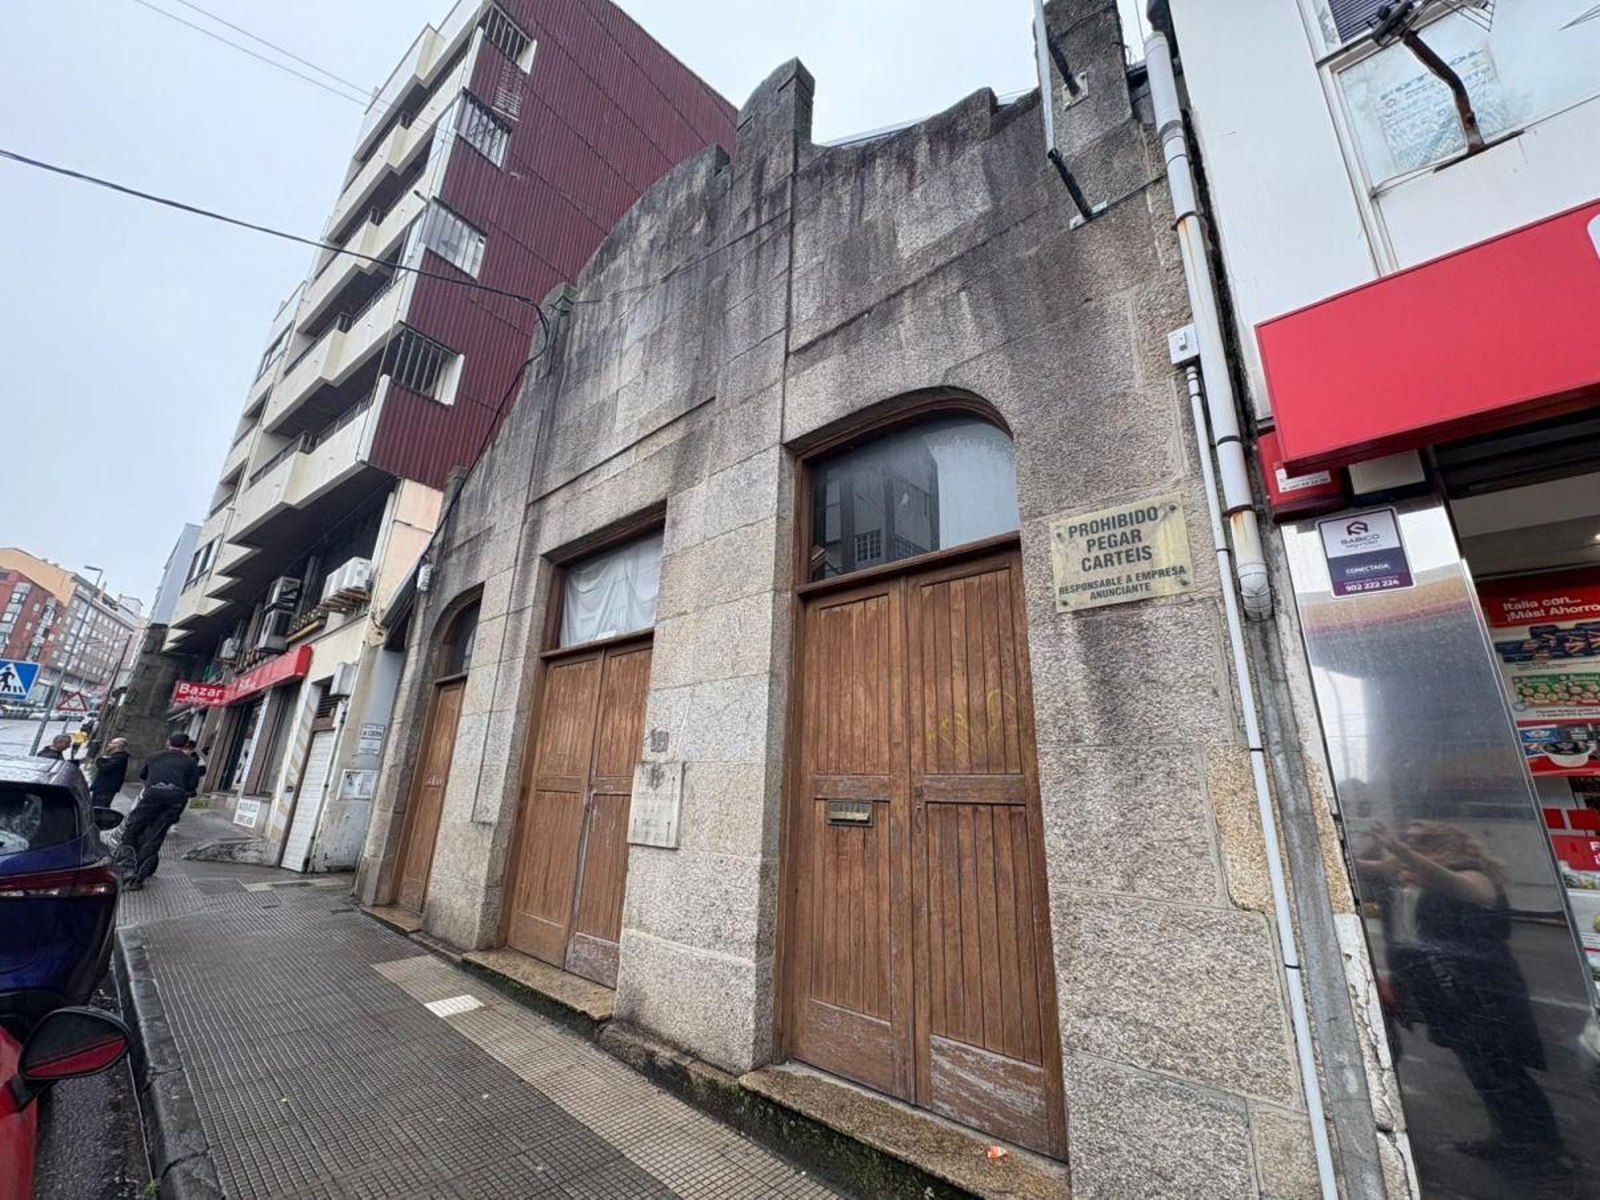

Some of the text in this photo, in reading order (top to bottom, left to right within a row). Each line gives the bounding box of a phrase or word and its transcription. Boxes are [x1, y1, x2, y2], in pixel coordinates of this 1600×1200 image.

[1068, 506, 1158, 539] PROHIBIDO
[1086, 528, 1142, 553] PEGAR
[1081, 545, 1153, 573] CARTEIS
[1058, 565, 1187, 595] RESPONSABLE A EMPRESA
[1345, 583, 1362, 592] 902
[1363, 581, 1381, 590] 222
[1090, 582, 1152, 600] ANUNCIANTE
[1503, 600, 1538, 611] Italia
[179, 683, 223, 698] Bazar
